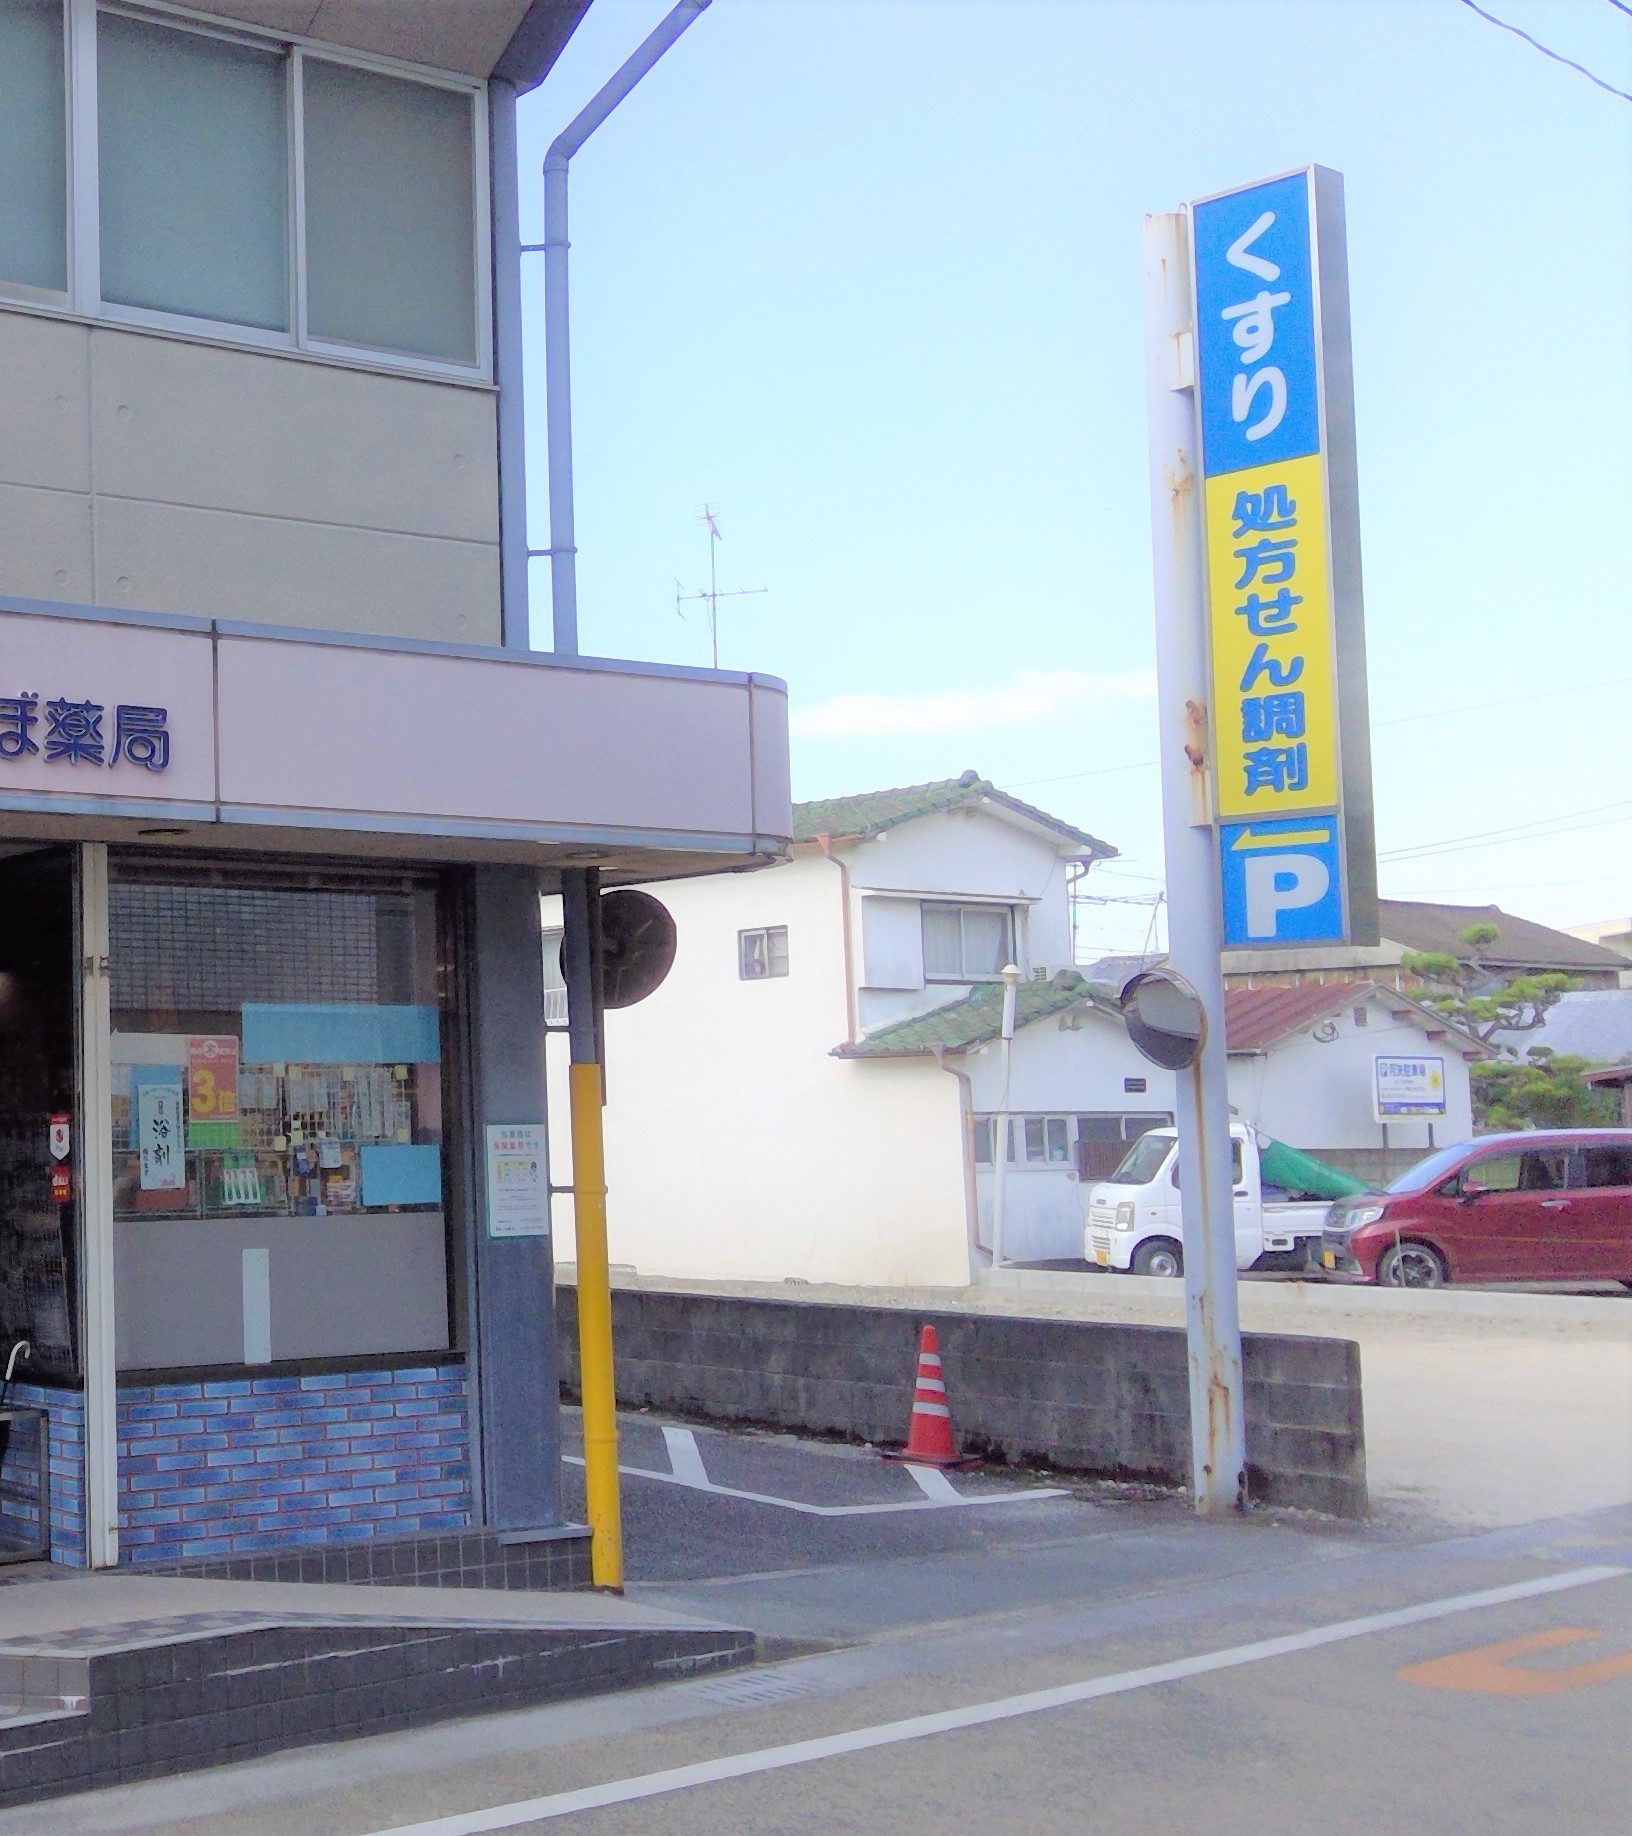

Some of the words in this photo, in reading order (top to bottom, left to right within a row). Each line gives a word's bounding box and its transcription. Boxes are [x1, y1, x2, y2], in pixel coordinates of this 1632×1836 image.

[1221, 210, 1291, 442] くすり
[1231, 482, 1309, 797] 処方せん調剤
[1244, 853, 1330, 938] P
